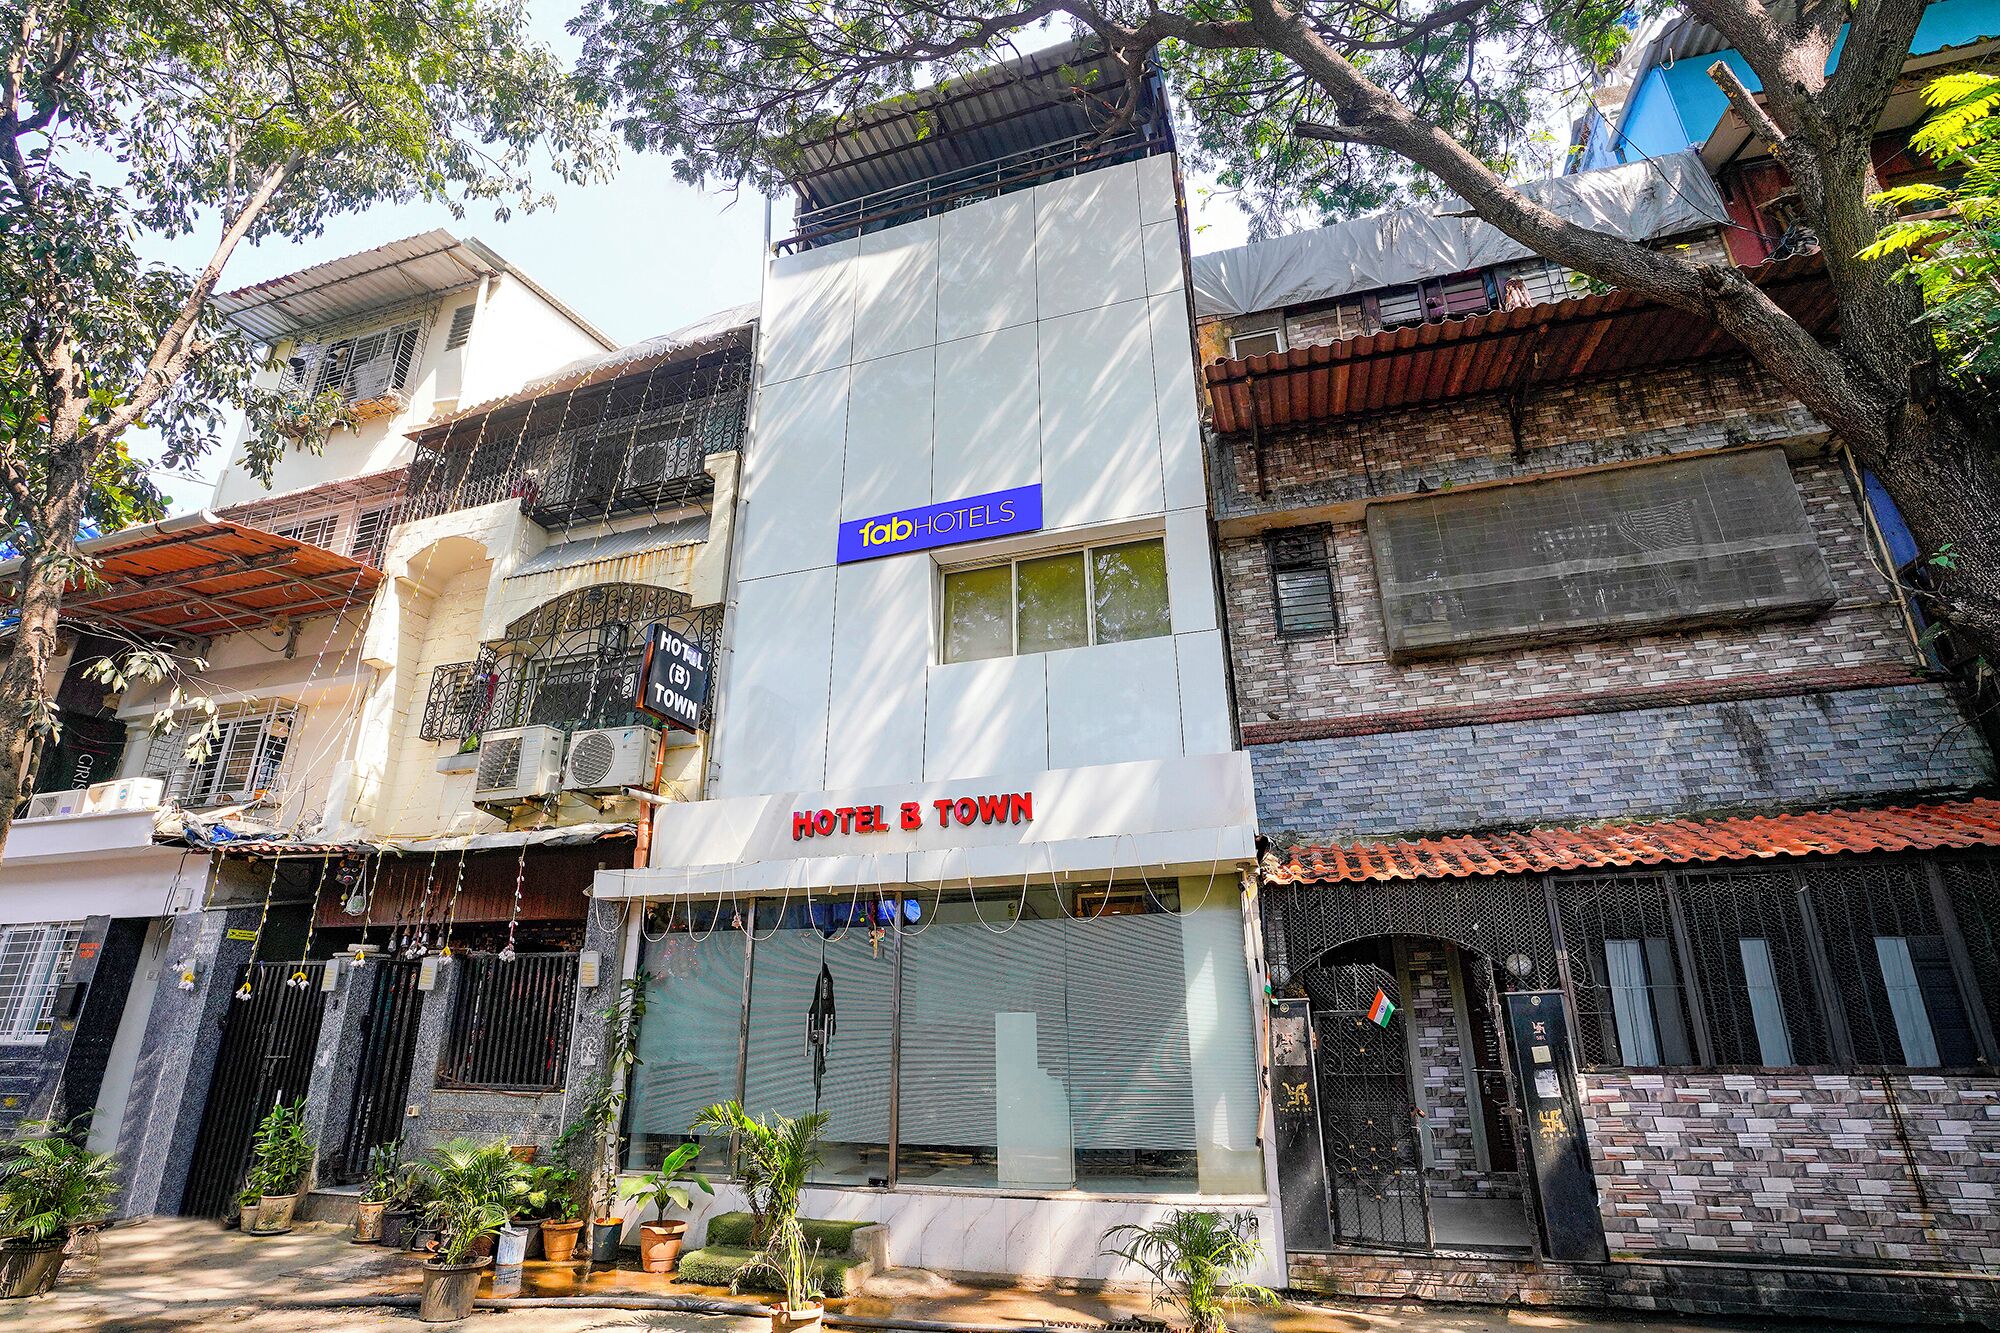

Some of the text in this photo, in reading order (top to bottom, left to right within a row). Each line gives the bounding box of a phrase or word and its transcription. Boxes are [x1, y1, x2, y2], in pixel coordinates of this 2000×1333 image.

[660, 630, 704, 671] HOTEL
[668, 662, 691, 691] (B)
[654, 682, 698, 720] TOWN
[792, 791, 1034, 842] HOTEL B TOWN
